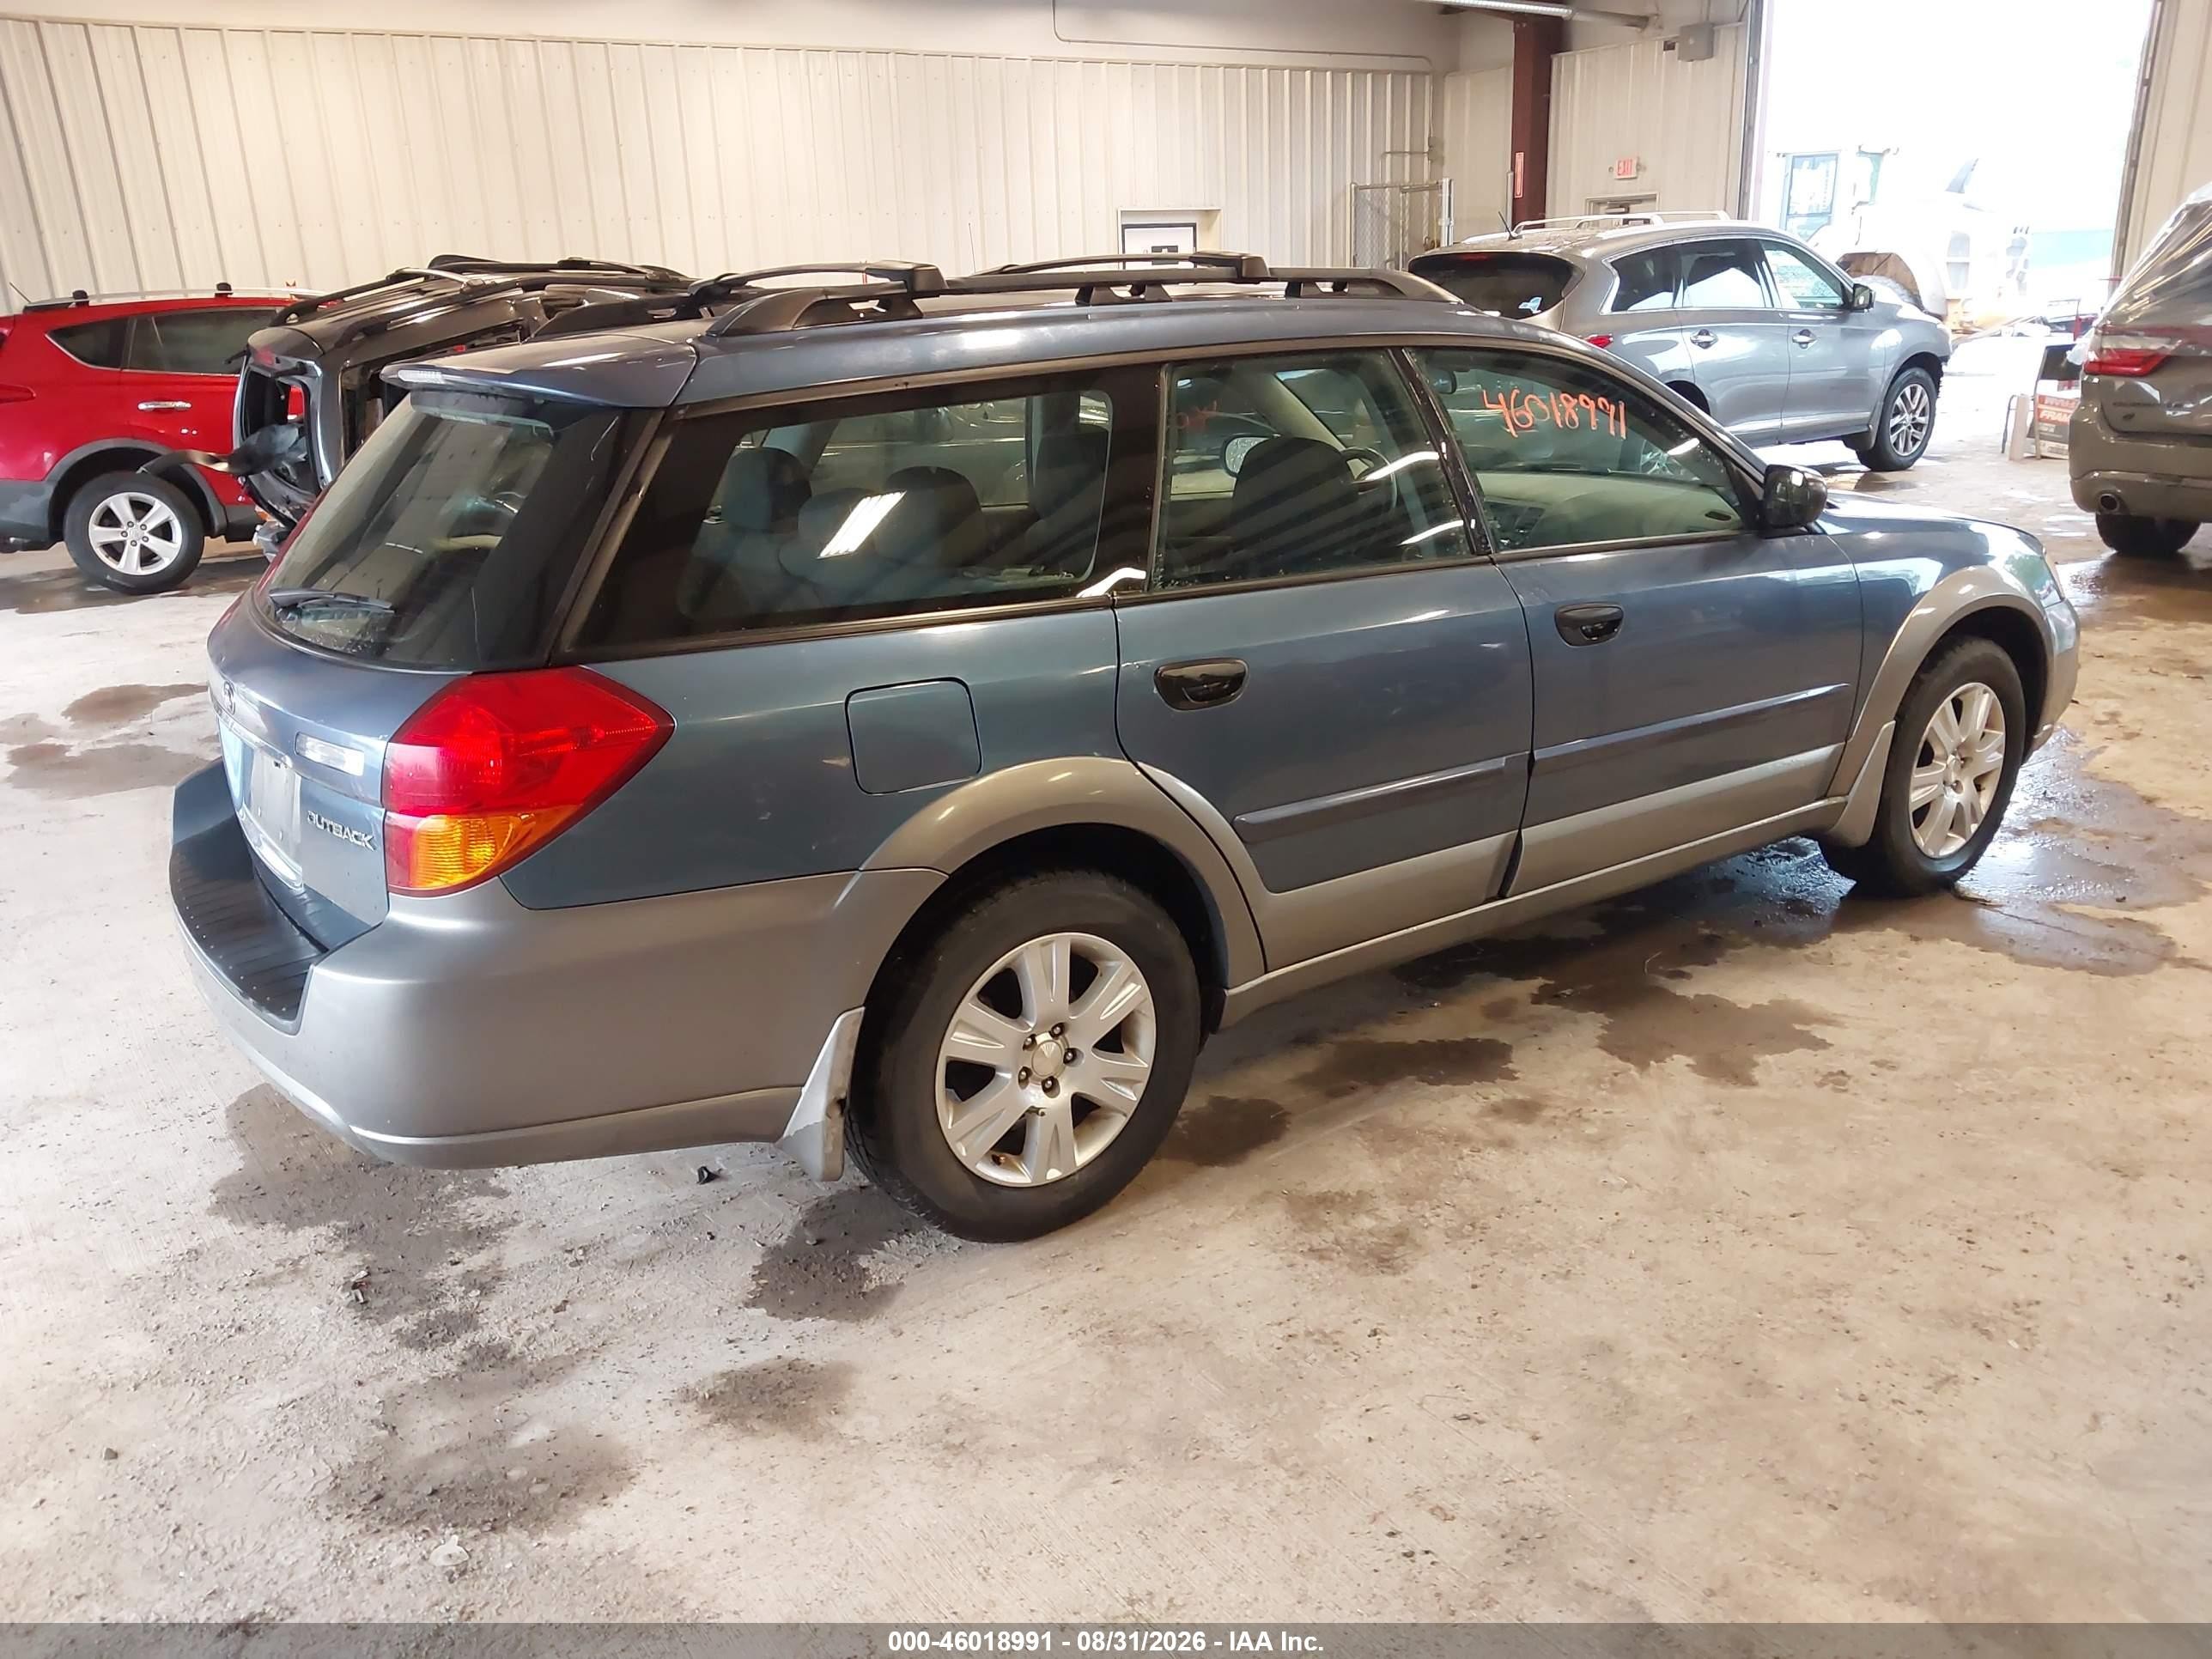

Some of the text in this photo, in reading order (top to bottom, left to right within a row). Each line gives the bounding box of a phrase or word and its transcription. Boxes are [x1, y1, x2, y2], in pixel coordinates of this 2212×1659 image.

[1617, 159, 1632, 176] EXIT
[1483, 388, 1626, 440] 46018991
[307, 810, 376, 852] OUTBACK
